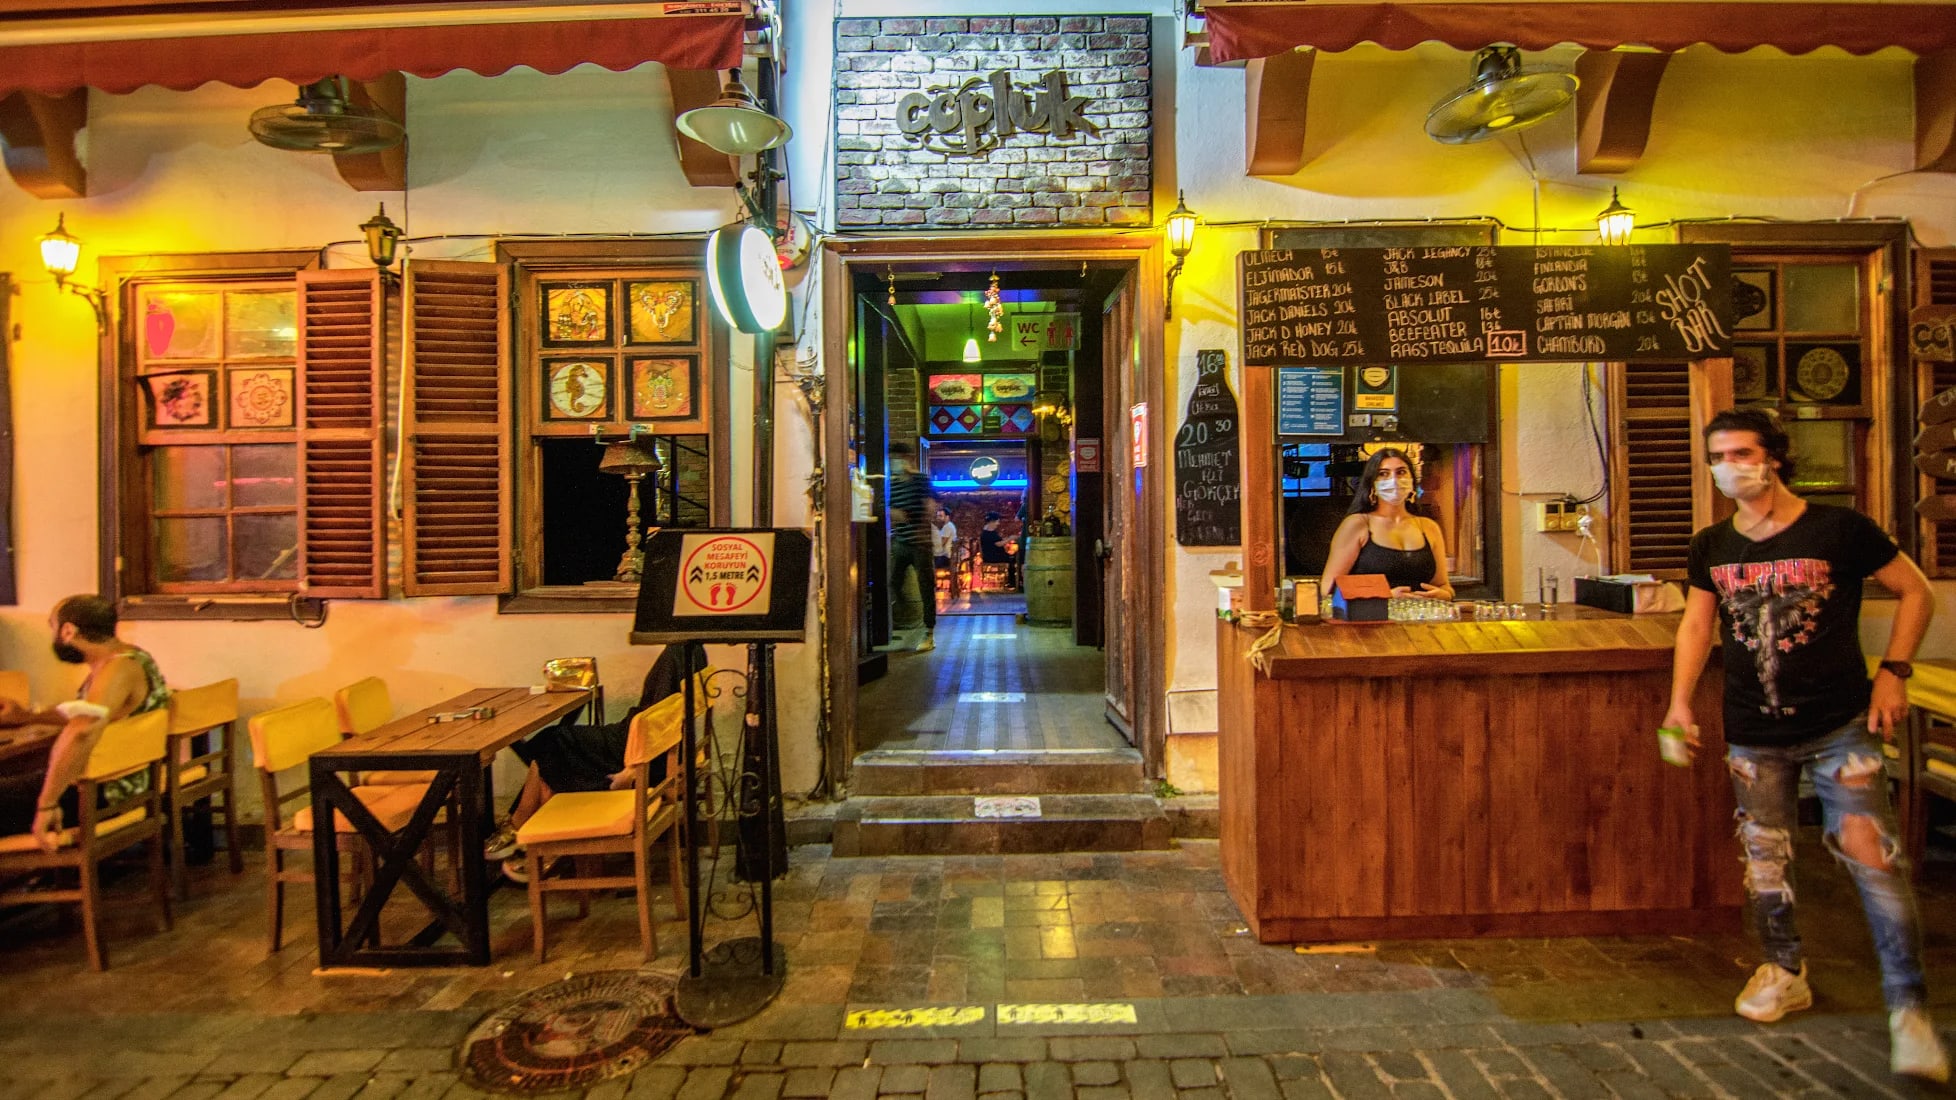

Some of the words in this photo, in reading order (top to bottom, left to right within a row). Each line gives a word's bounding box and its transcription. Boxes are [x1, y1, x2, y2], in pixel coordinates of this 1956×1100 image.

[1383, 247, 1415, 260] JACK
[1383, 261, 1409, 274] J&B
[1384, 272, 1444, 290] JAMESON
[1656, 257, 1711, 320] SHOT
[1383, 293, 1424, 310] BLACK
[1428, 290, 1470, 305] LABEL
[1245, 309, 1277, 326] JACK
[1387, 307, 1453, 328] ABSOLUT
[1586, 310, 1631, 328] MORGAN
[1671, 300, 1731, 352] BAR
[1017, 322, 1040, 334] WC
[1246, 327, 1277, 343] JACK
[1281, 326, 1290, 339] D
[1295, 321, 1331, 338] HONEY
[1389, 321, 1467, 342] BEEFEATER
[1246, 344, 1277, 359] JACK
[1279, 341, 1306, 358] RED
[1311, 341, 1338, 357] DOG
[1536, 334, 1606, 354] CHAMBORD
[1178, 450, 1233, 469] MEHMET
[711, 543, 742, 551] SOSYAL
[704, 562, 746, 570] KORUYUN
[705, 571, 718, 581] 1,5
[719, 571, 744, 580] METRE
